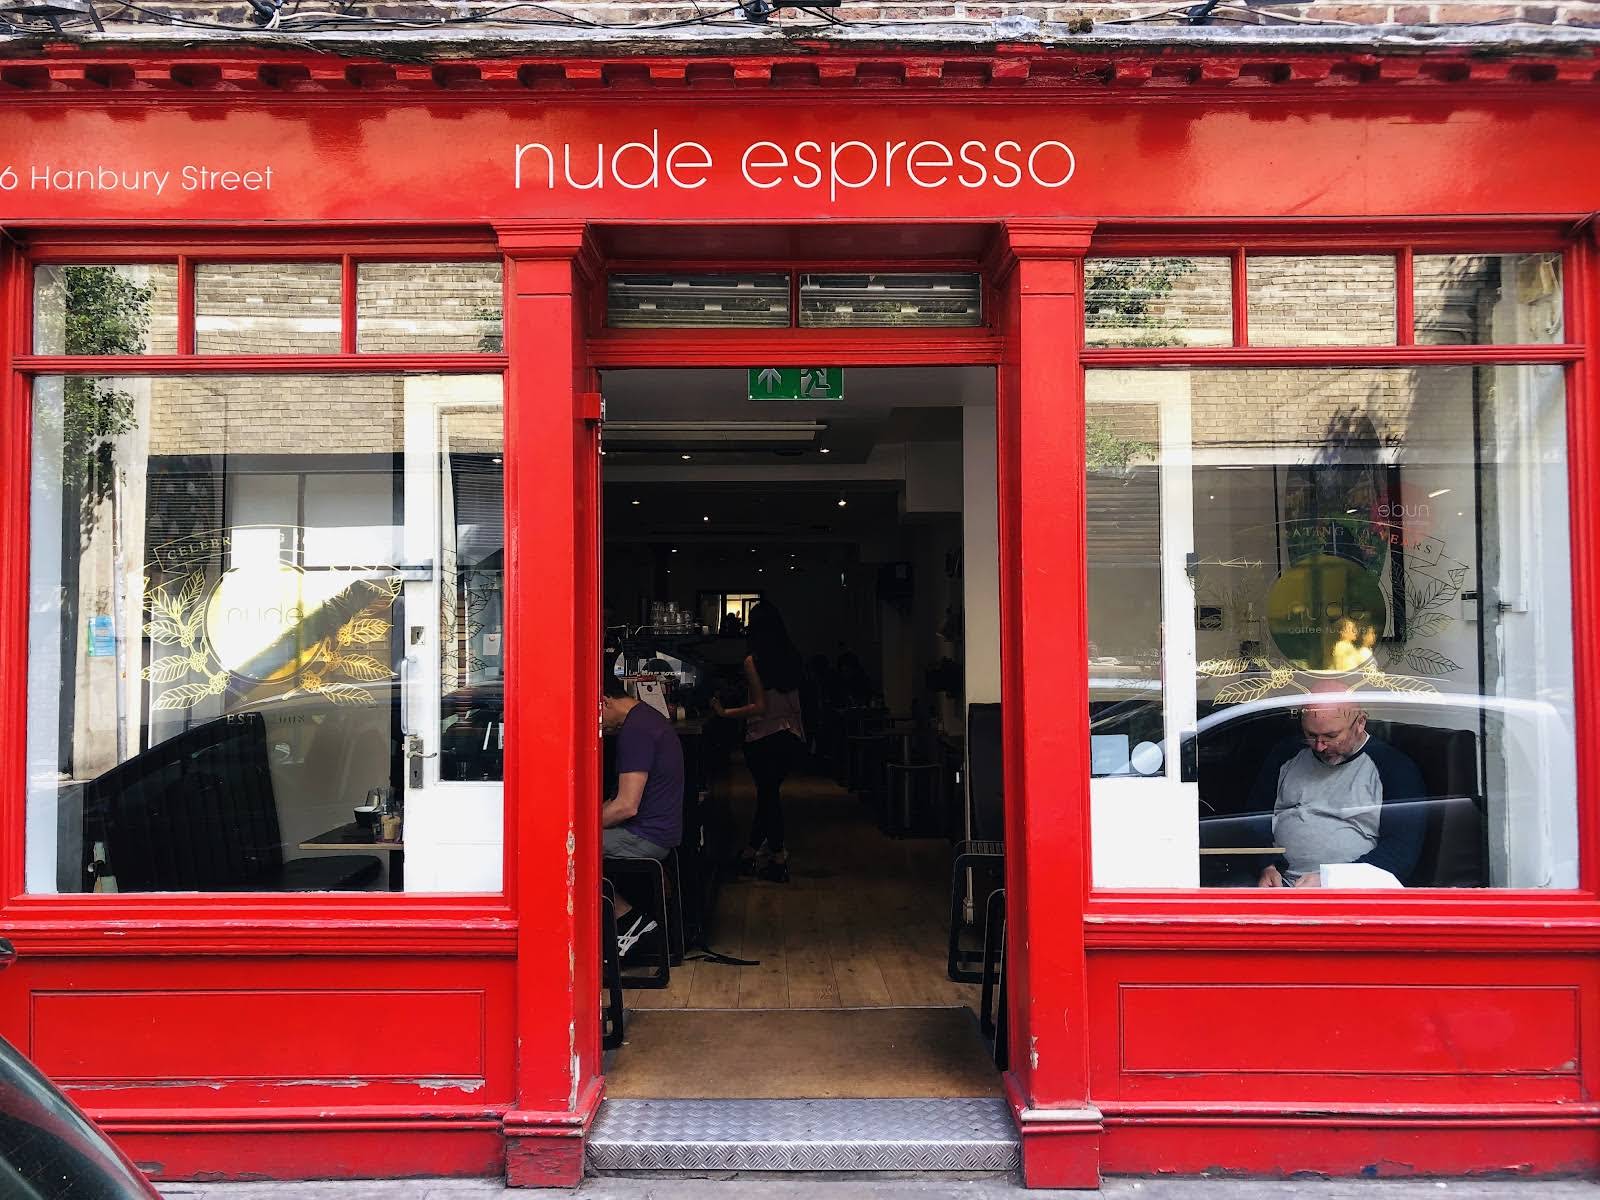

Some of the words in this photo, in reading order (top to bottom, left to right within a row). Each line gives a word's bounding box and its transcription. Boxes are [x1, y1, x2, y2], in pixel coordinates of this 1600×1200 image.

[515, 129, 713, 190] nude
[741, 140, 1076, 202] espresso
[31, 166, 169, 195] Hanbury
[181, 166, 273, 191] Street
[226, 713, 257, 725] EST
